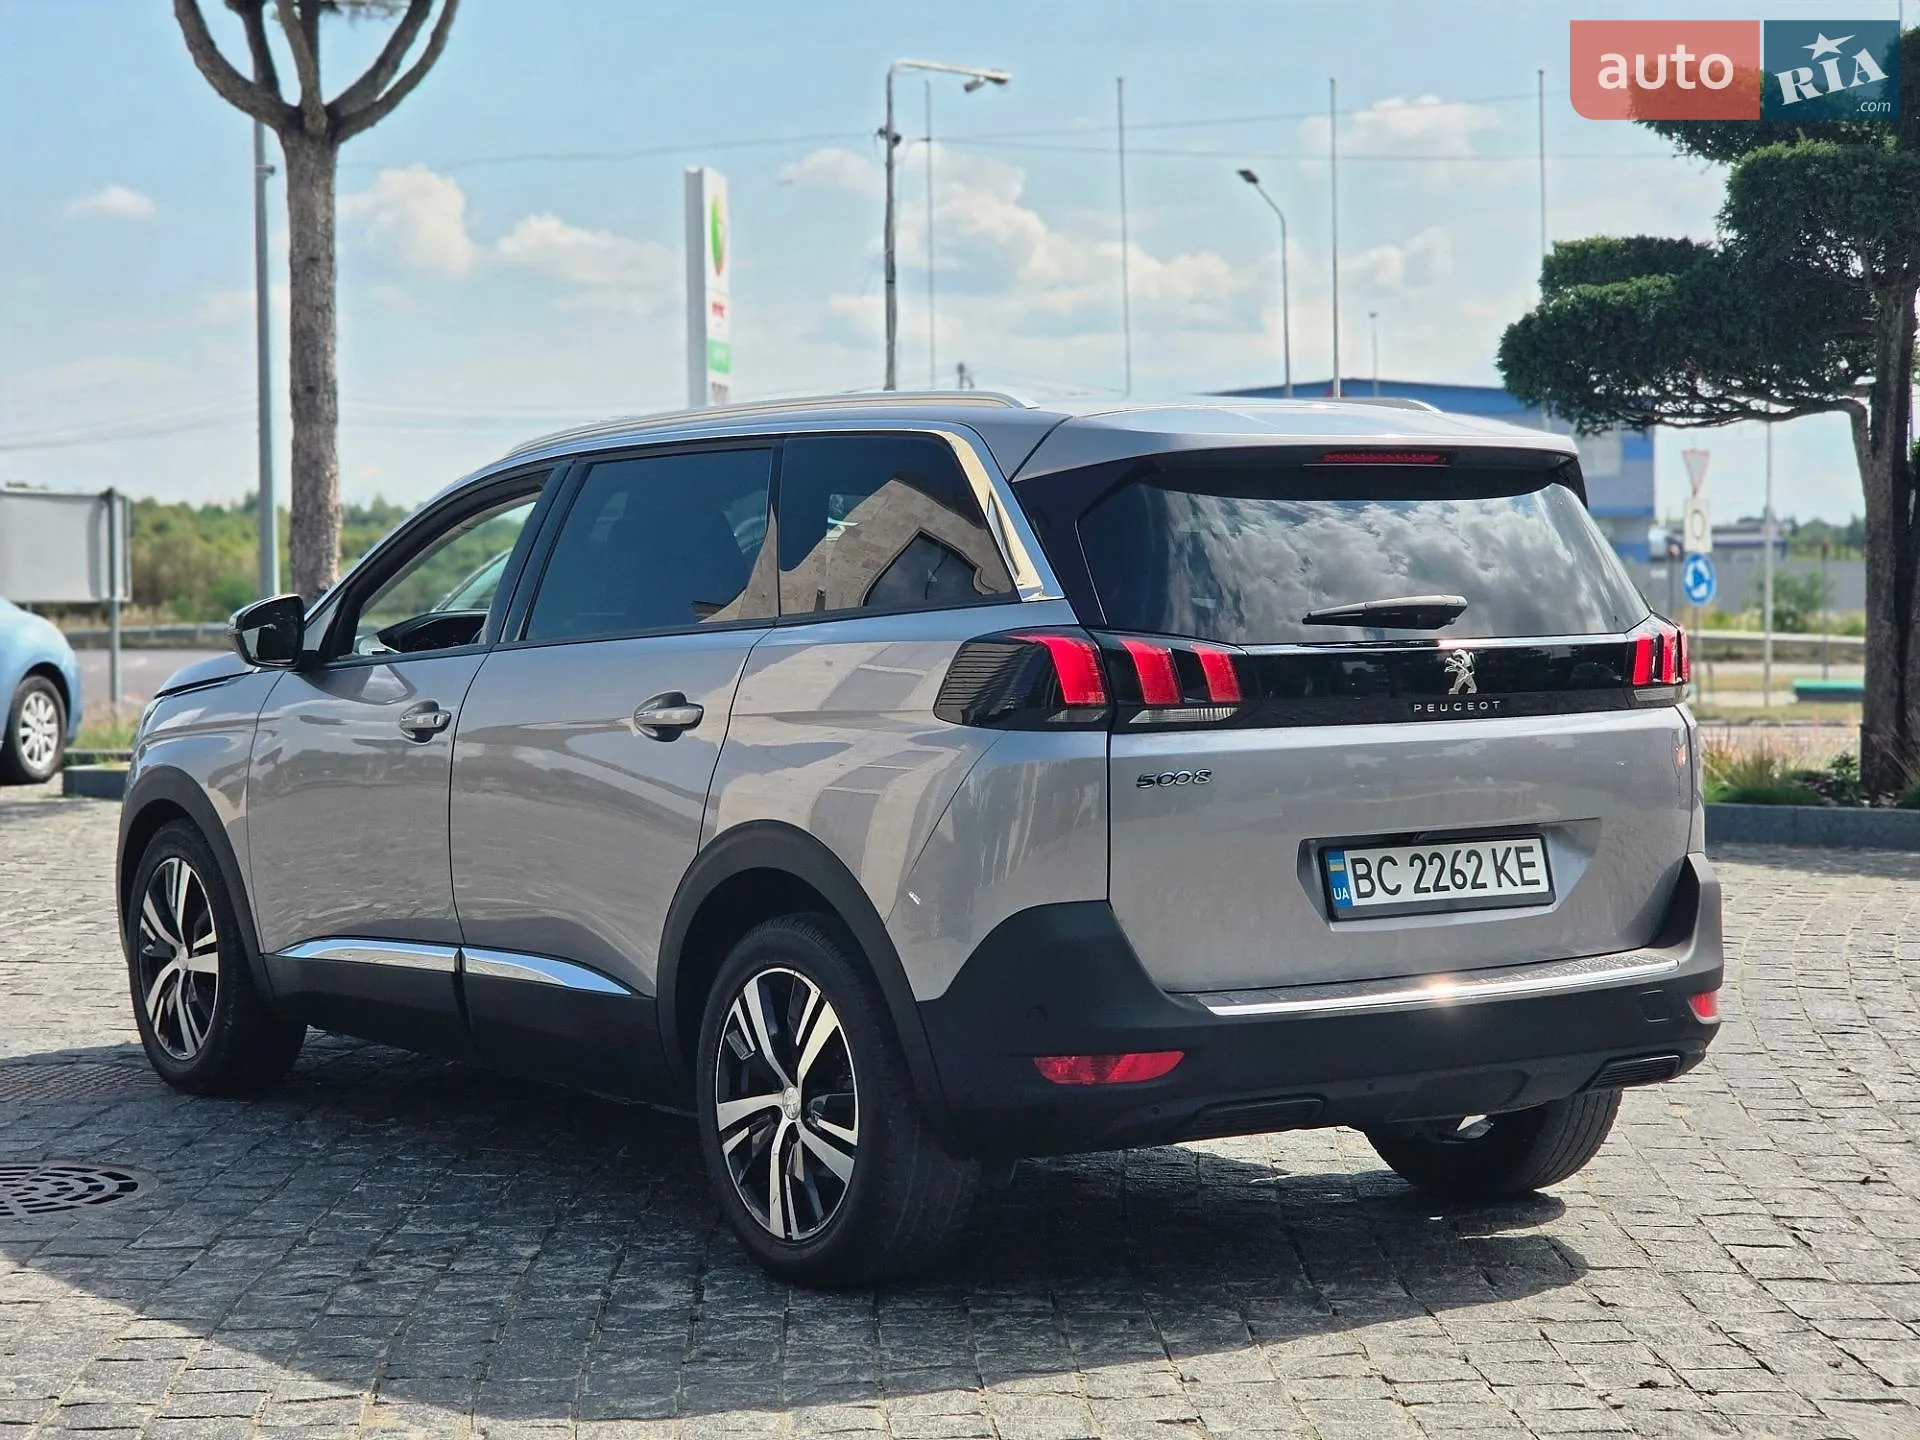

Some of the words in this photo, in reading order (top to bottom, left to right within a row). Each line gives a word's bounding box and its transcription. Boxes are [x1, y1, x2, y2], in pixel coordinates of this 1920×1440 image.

[1413, 700, 1501, 713] PEUGEOT
[1135, 768, 1212, 789] 5008
[1350, 855, 1402, 899] BC
[1408, 849, 1488, 894] 2262
[1491, 845, 1541, 888] KE
[1333, 887, 1350, 901] UA
